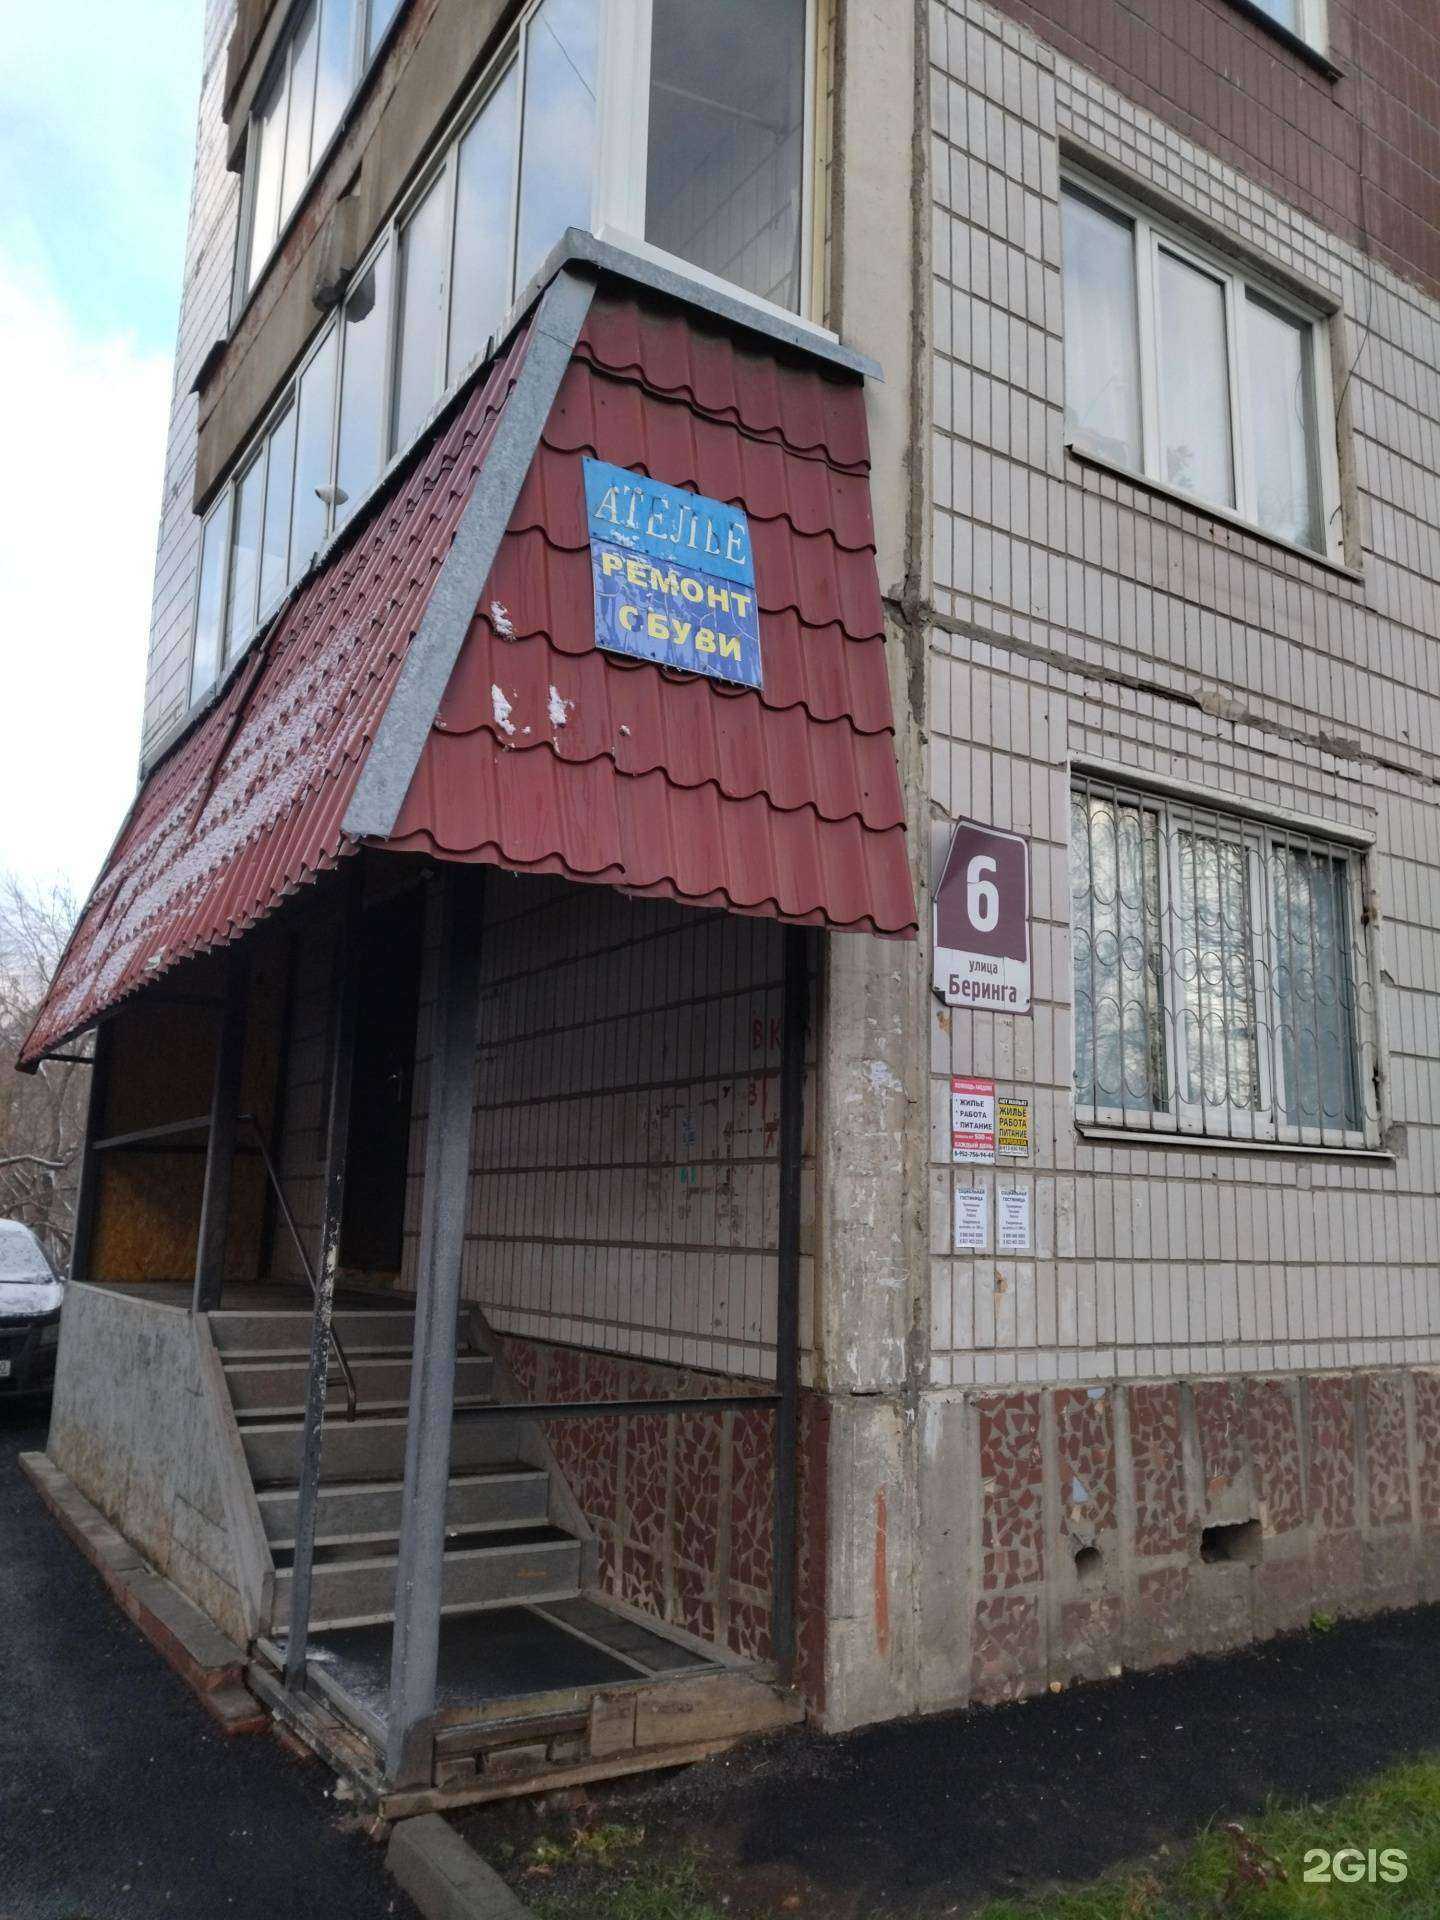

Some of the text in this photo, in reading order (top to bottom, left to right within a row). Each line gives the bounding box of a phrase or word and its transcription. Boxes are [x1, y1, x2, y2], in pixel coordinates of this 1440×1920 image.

[593, 484, 747, 565] АТЕЛЬЕ
[601, 552, 751, 618] РЕМОНТ
[966, 854, 1000, 933] 6
[968, 959, 999, 975] улица
[949, 973, 1018, 1003] Беринга
[960, 1099, 985, 1108] ЖИЛЬЕ
[960, 1110, 987, 1119] РАБОТА
[999, 1106, 1027, 1117] ЖИЛЬЕ
[960, 1121, 993, 1131] ПИТАНИЕ
[999, 1117, 1027, 1128] РАБОТА
[999, 1128, 1027, 1139] ПИТАНИЕ
